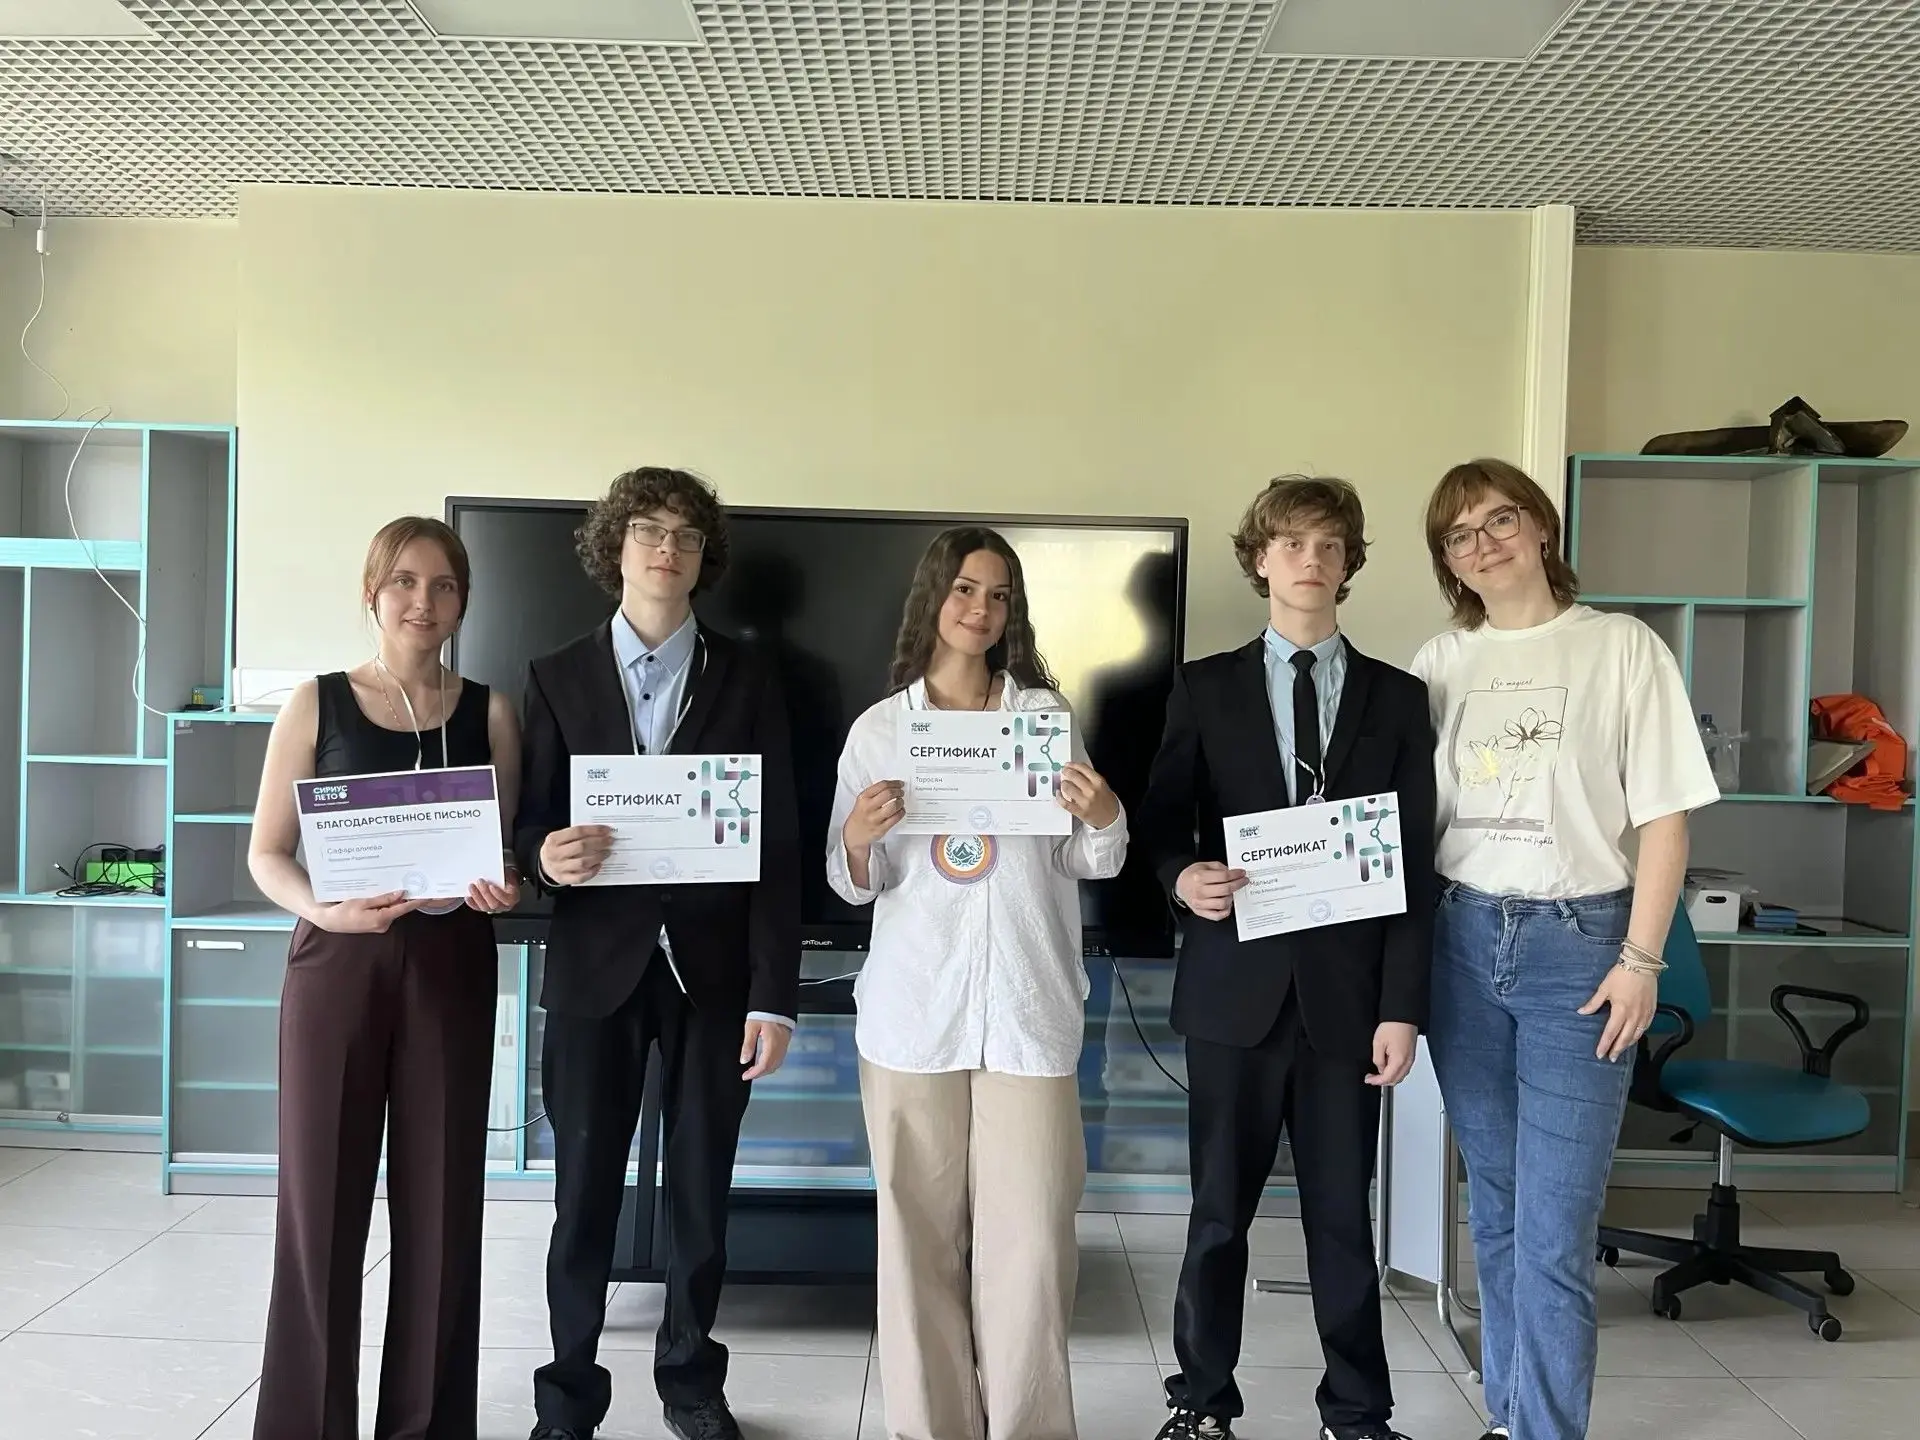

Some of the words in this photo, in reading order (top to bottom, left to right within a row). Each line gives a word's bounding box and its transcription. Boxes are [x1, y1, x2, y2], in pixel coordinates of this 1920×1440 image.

[1505, 678, 1533, 689] magical
[910, 746, 997, 758] СЕРТИФИКАТ
[313, 785, 348, 794] СИРИУС
[315, 792, 338, 801] ЛЕТО
[586, 793, 682, 806] СЕРТИФИКАТ
[316, 812, 432, 830] БЛАГОДАРСТВЕННОЕ
[434, 809, 481, 821] ПИСЬМО
[1241, 839, 1328, 863] СЕРТИФИКАТ
